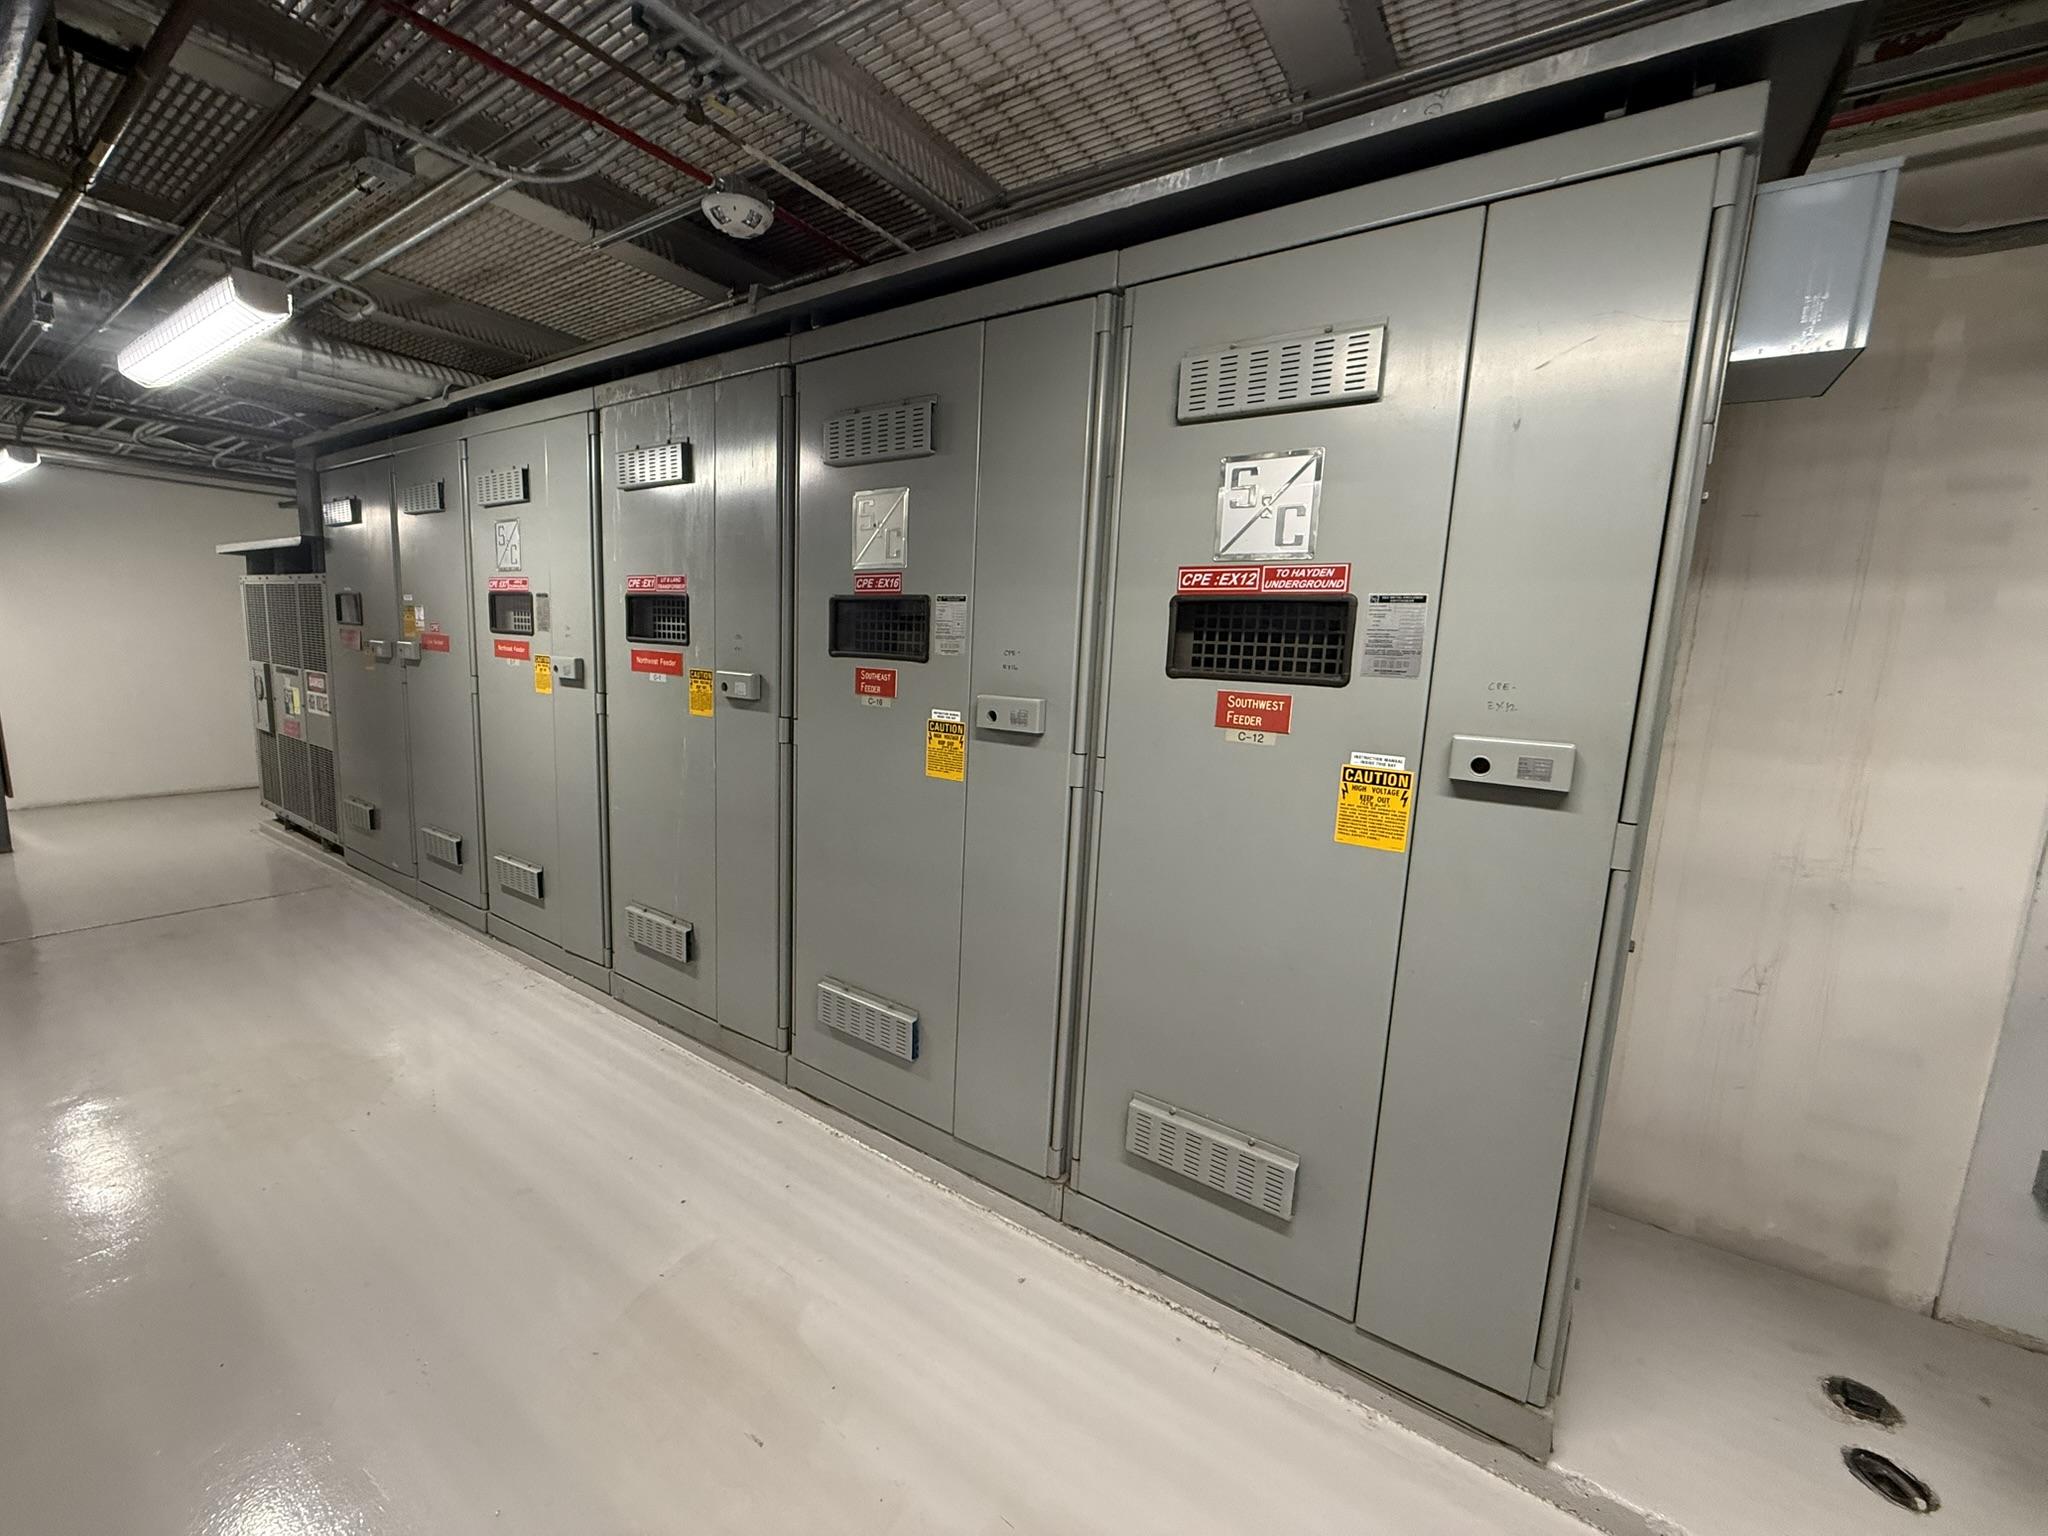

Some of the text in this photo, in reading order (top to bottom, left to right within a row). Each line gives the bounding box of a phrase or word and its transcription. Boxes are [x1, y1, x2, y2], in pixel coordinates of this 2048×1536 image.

[1276, 568, 1336, 577] TO HAYDEN
[856, 578, 899, 588] CPE :EX16
[1182, 573, 1257, 586] CPE :EX12
[1264, 579, 1345, 589] UNDERGROUND
[660, 658, 676, 667] Feeder
[860, 670, 891, 681] SOUTHEAST
[860, 682, 880, 693] FEEDER
[1227, 695, 1285, 711] SOUTHWEST
[1226, 710, 1262, 726] FEEDER
[929, 722, 963, 734] CAUTION
[1237, 731, 1264, 743] C-12
[1345, 768, 1409, 788] CAUTION
[1371, 787, 1401, 796] VOLTAGE
[1360, 794, 1374, 802] KEEP
